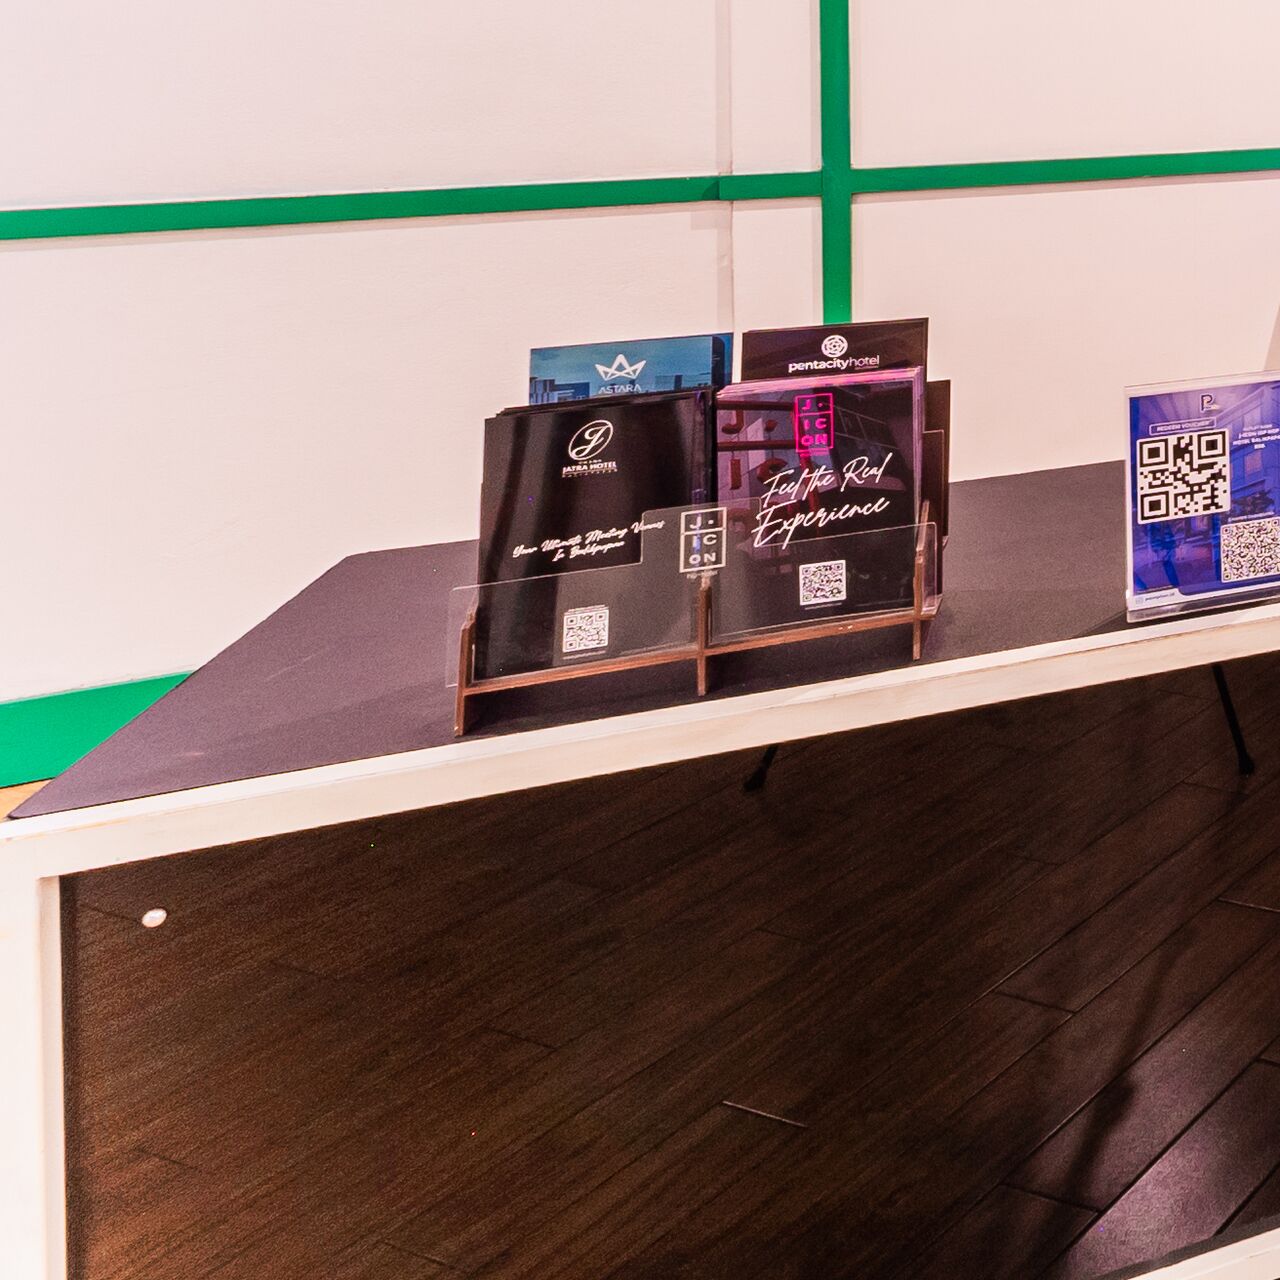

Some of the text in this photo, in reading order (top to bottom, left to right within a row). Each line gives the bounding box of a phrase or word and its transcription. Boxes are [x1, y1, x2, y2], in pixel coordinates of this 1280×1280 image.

[788, 355, 880, 373] pentacityhotel
[599, 383, 642, 395] ASTARA
[801, 433, 828, 446] ON
[562, 465, 588, 475] JATRA
[590, 461, 617, 470] HOTEL
[761, 452, 893, 508] Feel the Real
[751, 497, 890, 550] Experience
[585, 527, 628, 544] Meeting
[689, 552, 717, 565] ON
